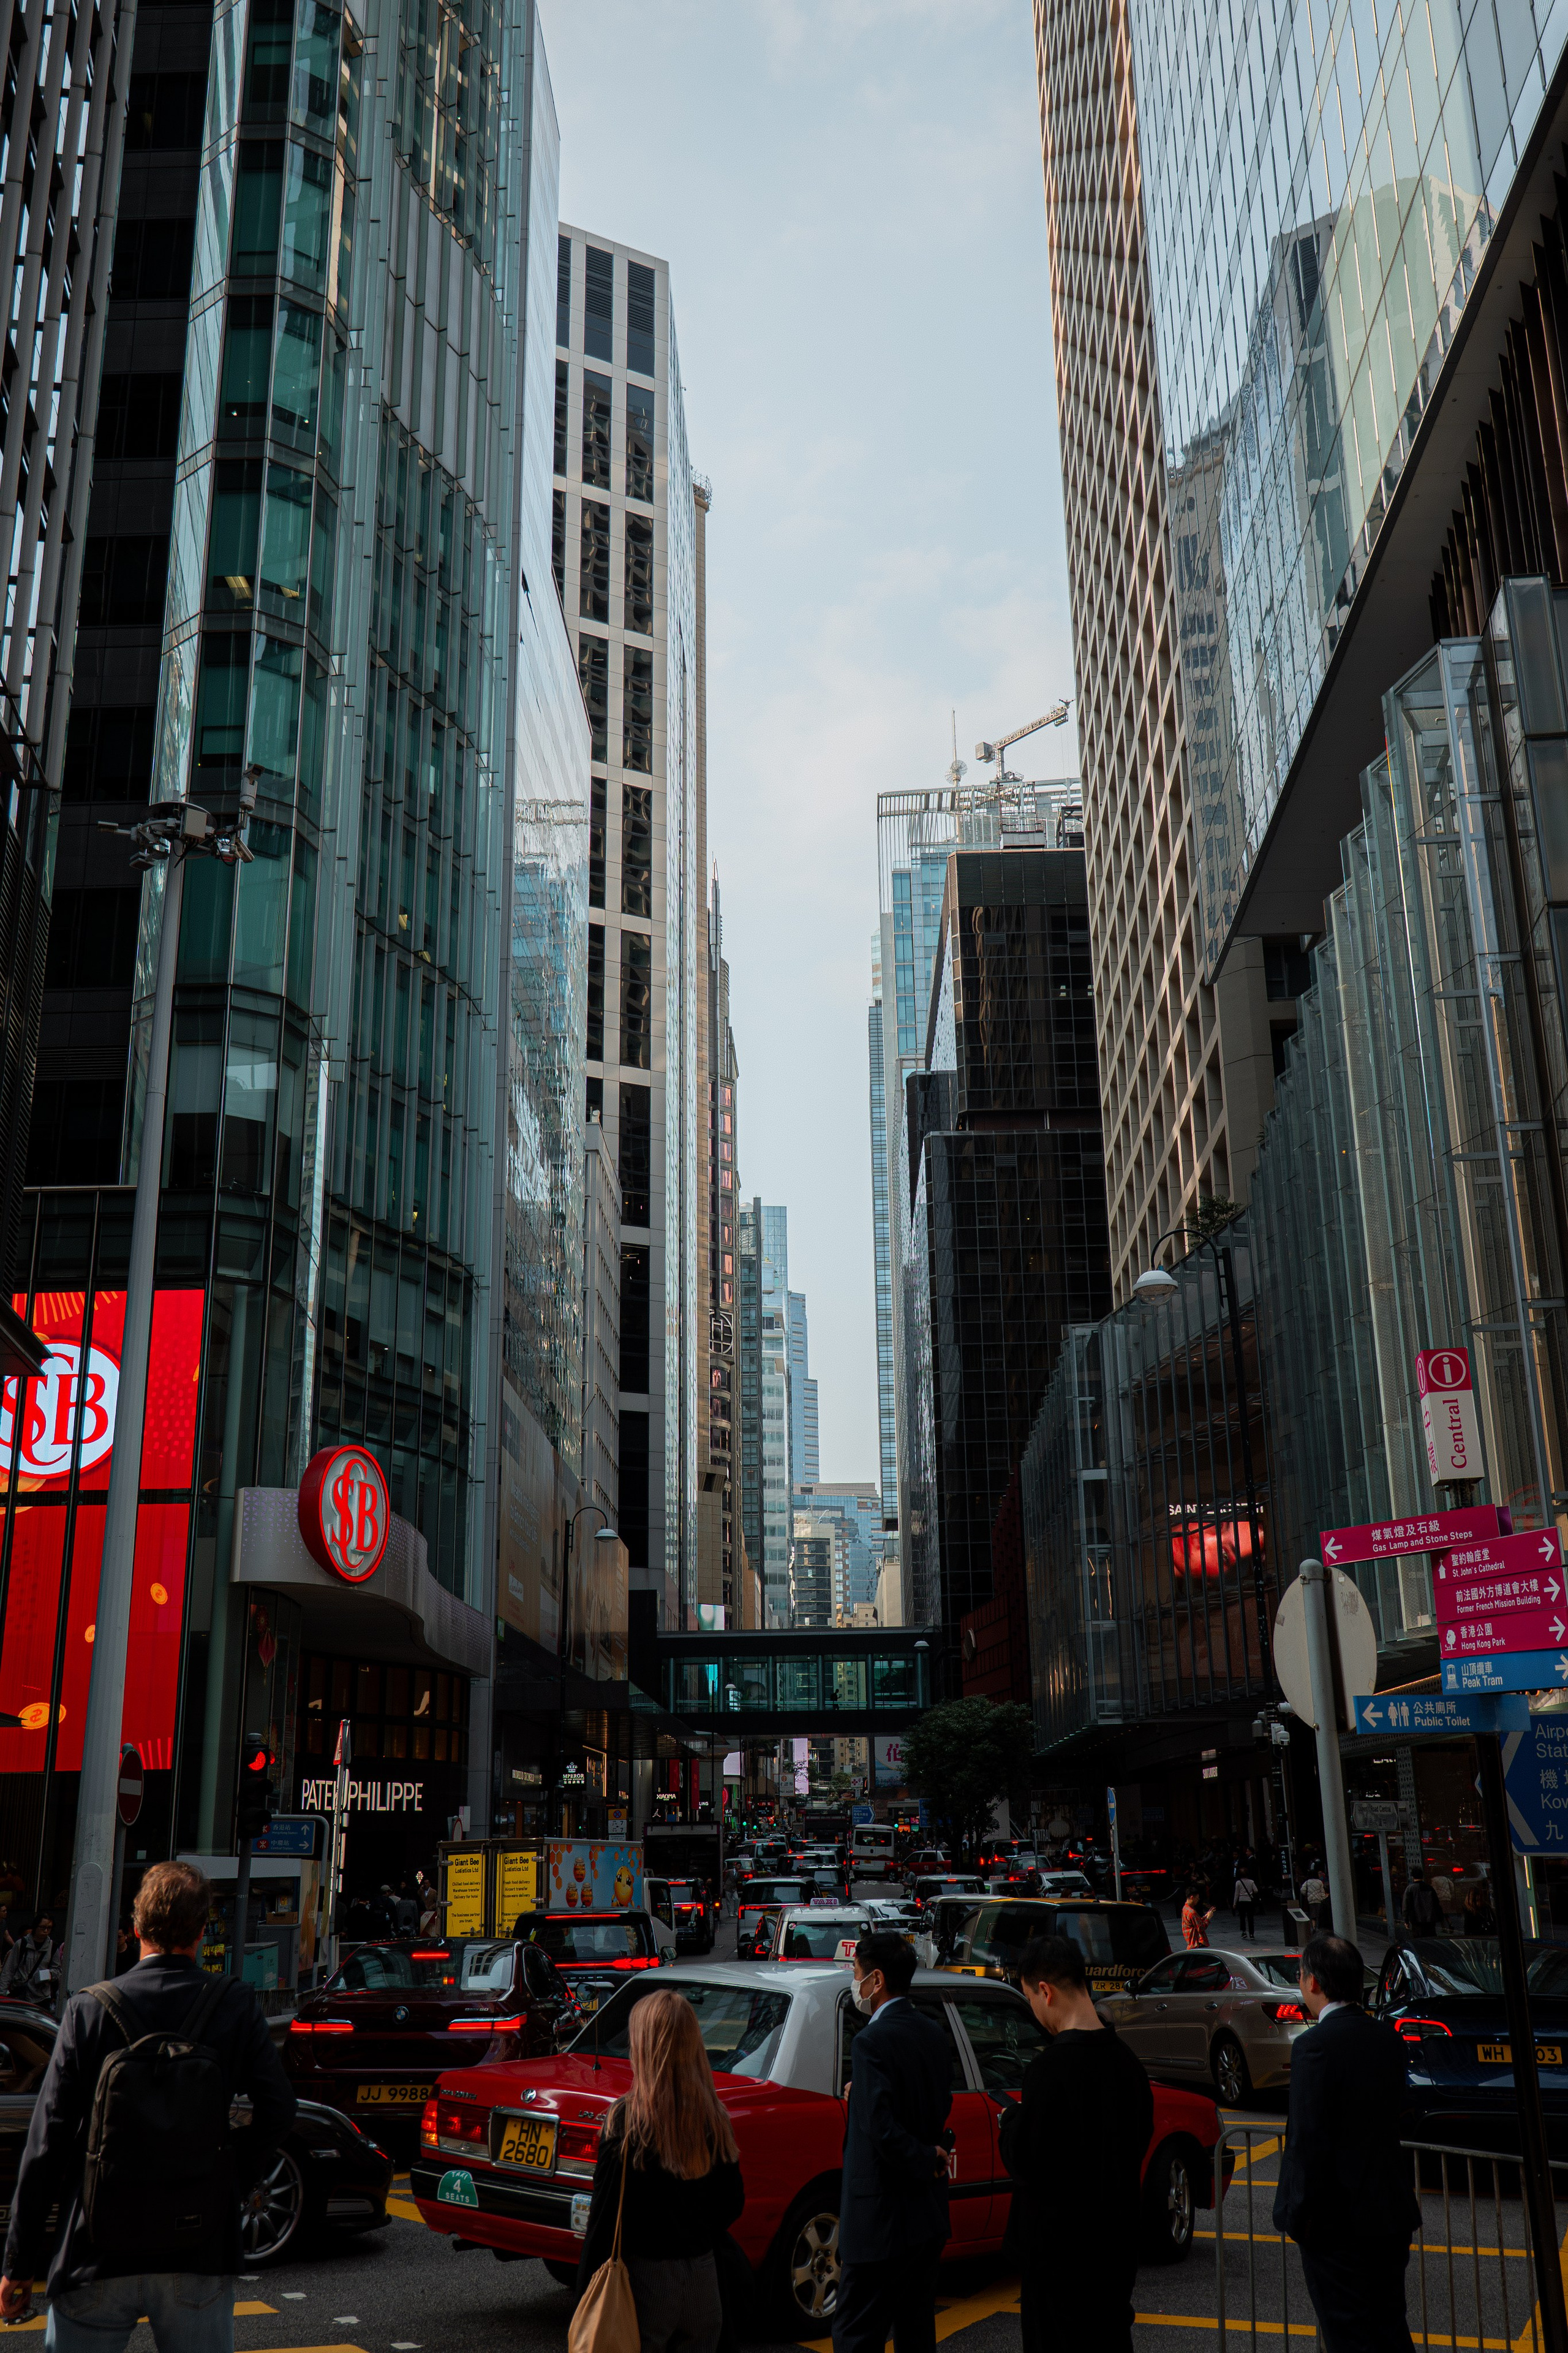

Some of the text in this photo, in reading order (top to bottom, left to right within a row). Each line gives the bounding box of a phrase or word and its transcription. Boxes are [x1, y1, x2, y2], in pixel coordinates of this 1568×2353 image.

[1423, 1405, 1438, 1474] 中環
[1442, 1398, 1468, 1469] Central
[1169, 1504, 1203, 1516] SAIN
[1371, 1520, 1440, 1541] 煤氣燈及石級
[1373, 1531, 1472, 1552] Gas Lamp and Stone Steps
[1451, 1547, 1490, 1566] 聖約翰座堂
[1478, 1560, 1506, 1573] Cathedral
[1457, 1595, 1541, 1614] Former French Mission Building
[1460, 1623, 1493, 1639] 香港公園
[1461, 1637, 1506, 1650] Hong Kong Park
[1461, 1661, 1493, 1676] 山頂纜車
[1462, 1675, 1503, 1688] Peak Tram
[1413, 1701, 1456, 1714] 公共廁所
[1414, 1716, 1470, 1726] Public Toilet
[1535, 1723, 1568, 1742] Airp
[1540, 1769, 1568, 1789] 機
[347, 1781, 423, 1811] PHILIPPE
[1085, 1964, 1149, 1978] uardforc
[1482, 2046, 1504, 2060] WH
[361, 2088, 382, 2101] JJ
[388, 2087, 428, 2101] 9988
[518, 2121, 542, 2143] HN
[503, 2140, 549, 2167] 2680
[453, 2179, 461, 2193] 4
[445, 2192, 470, 2203] SEATS
